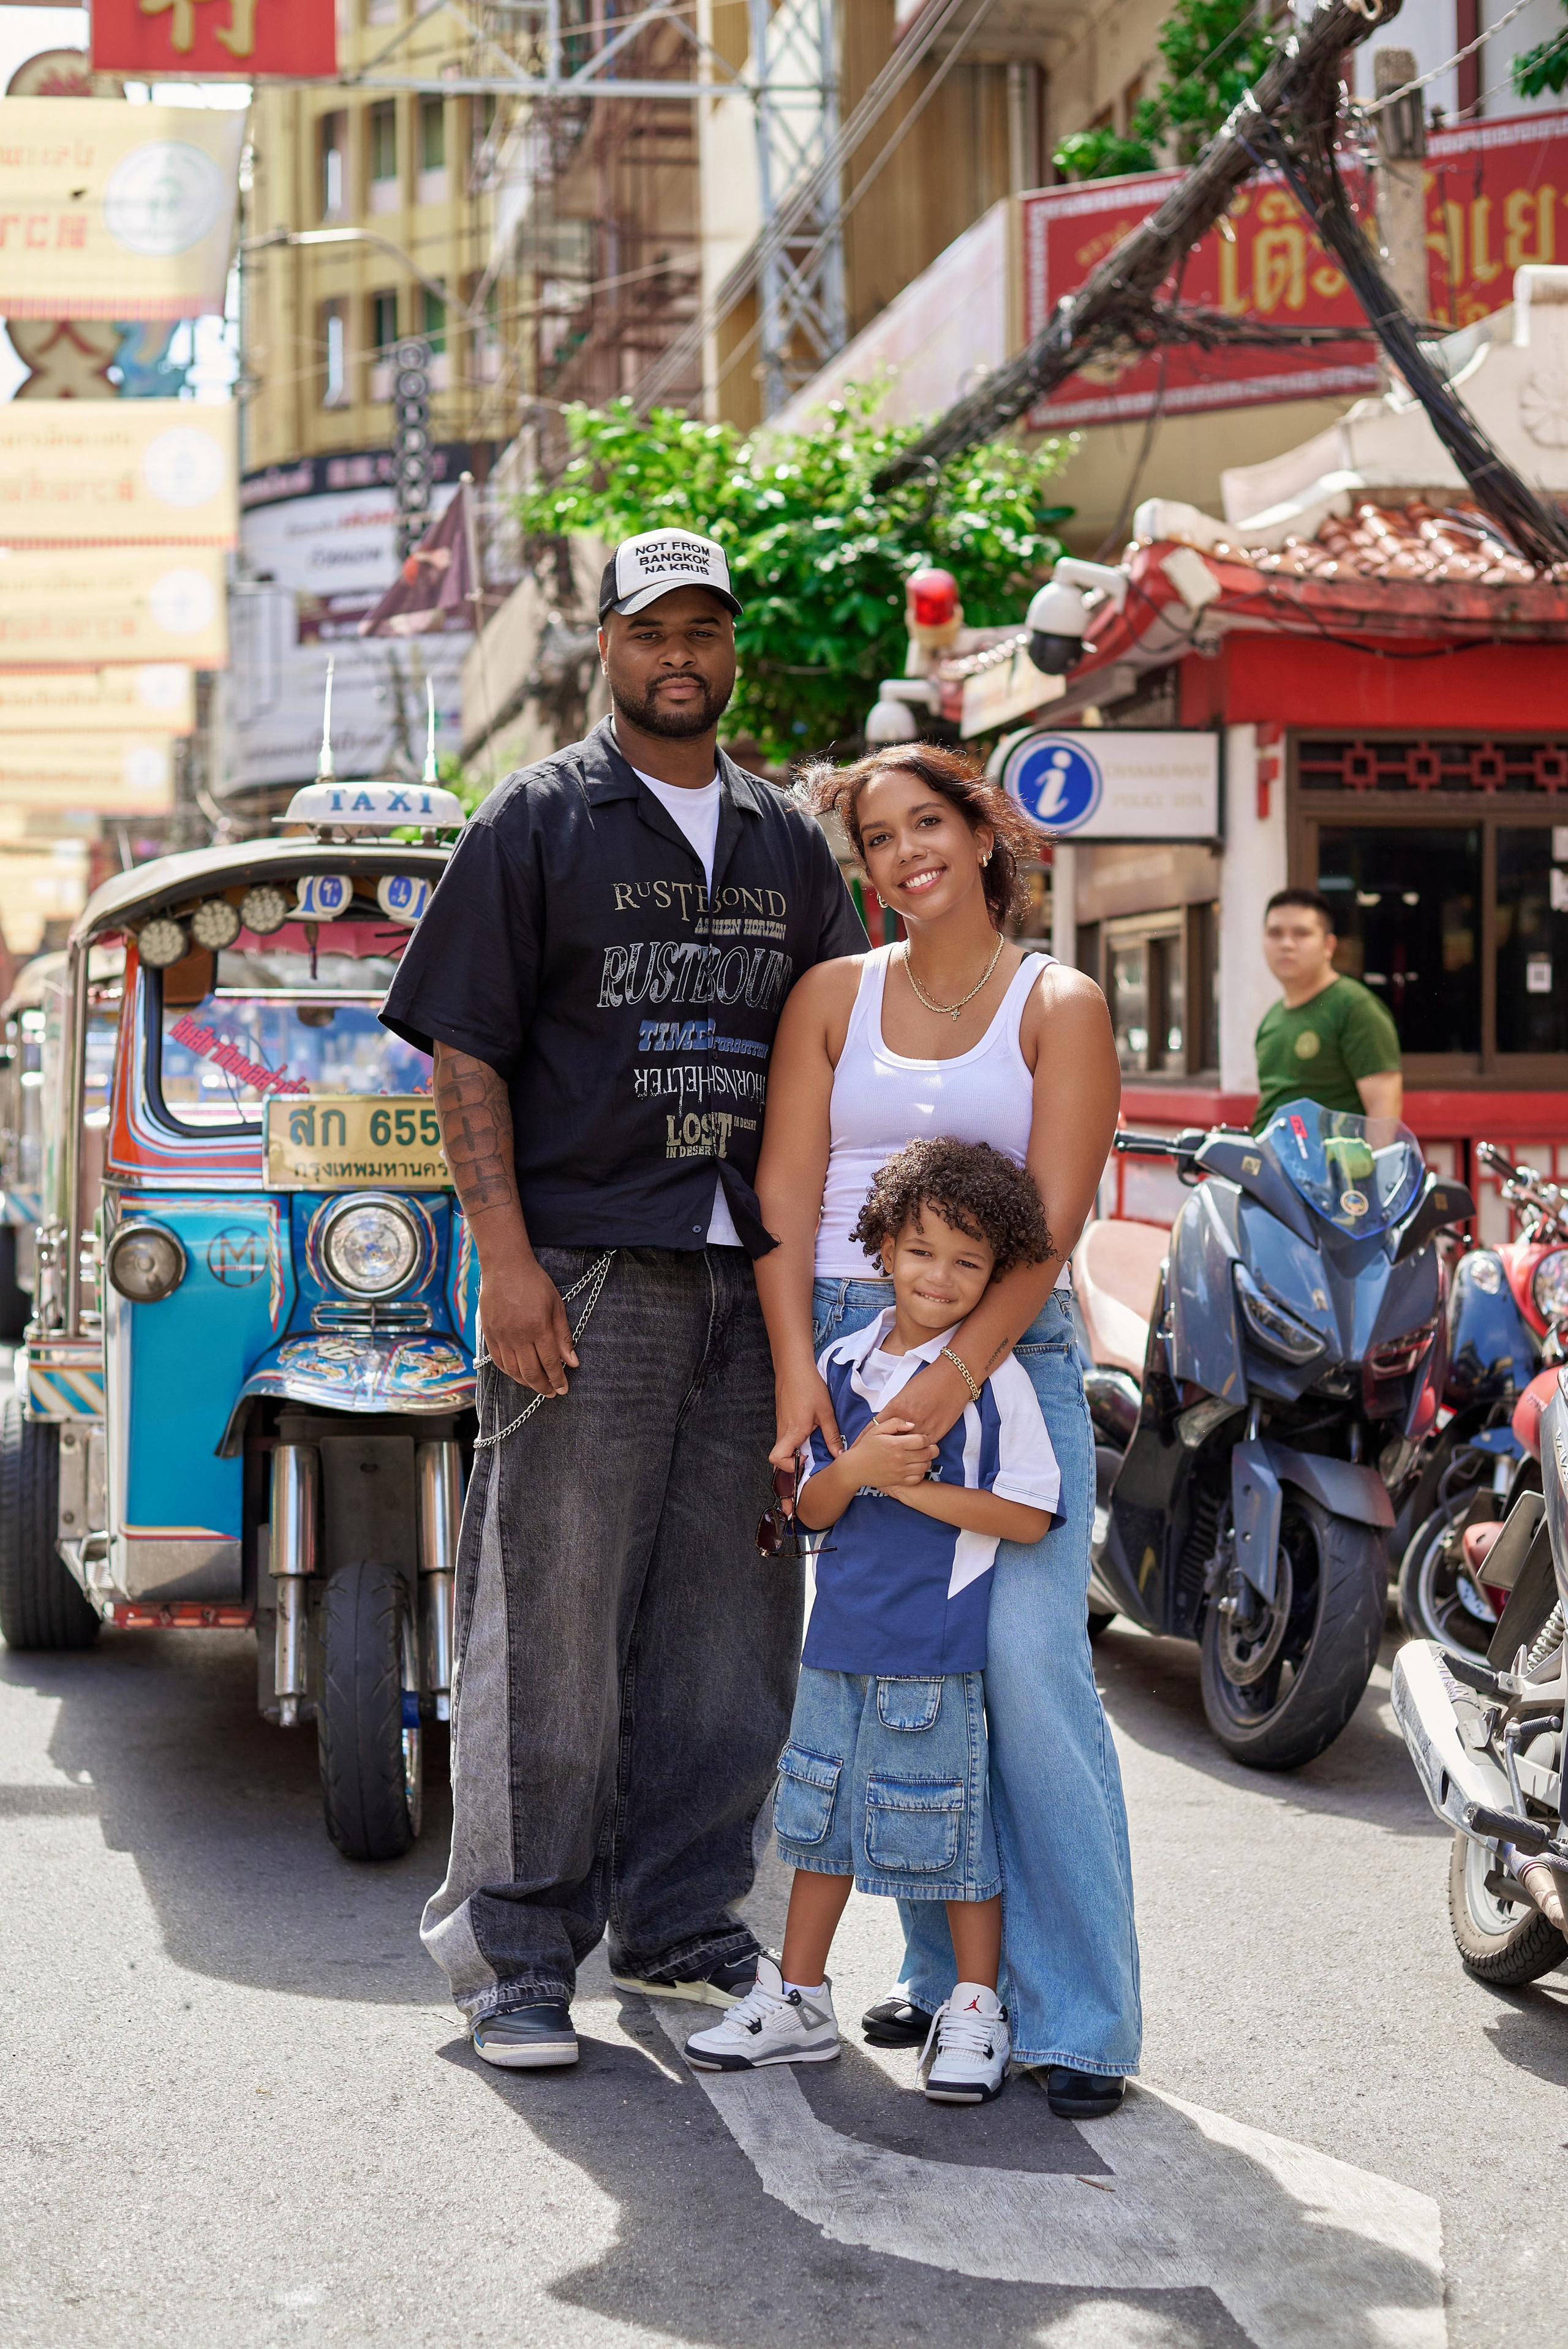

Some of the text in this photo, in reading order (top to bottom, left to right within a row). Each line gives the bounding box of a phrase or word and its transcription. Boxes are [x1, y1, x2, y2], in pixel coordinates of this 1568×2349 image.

[635, 541, 710, 557] NOT FROM
[639, 552, 711, 568] BANGKOK
[644, 564, 710, 576] NA KRUB
[326, 789, 432, 813] TAXI
[610, 880, 787, 922] RUSTBOND
[743, 919, 787, 941] HORIZON
[638, 1018, 716, 1052] TIME
[289, 1105, 346, 1146] สก
[666, 1112, 733, 1159] LOST
[666, 1147, 677, 1159] IN
